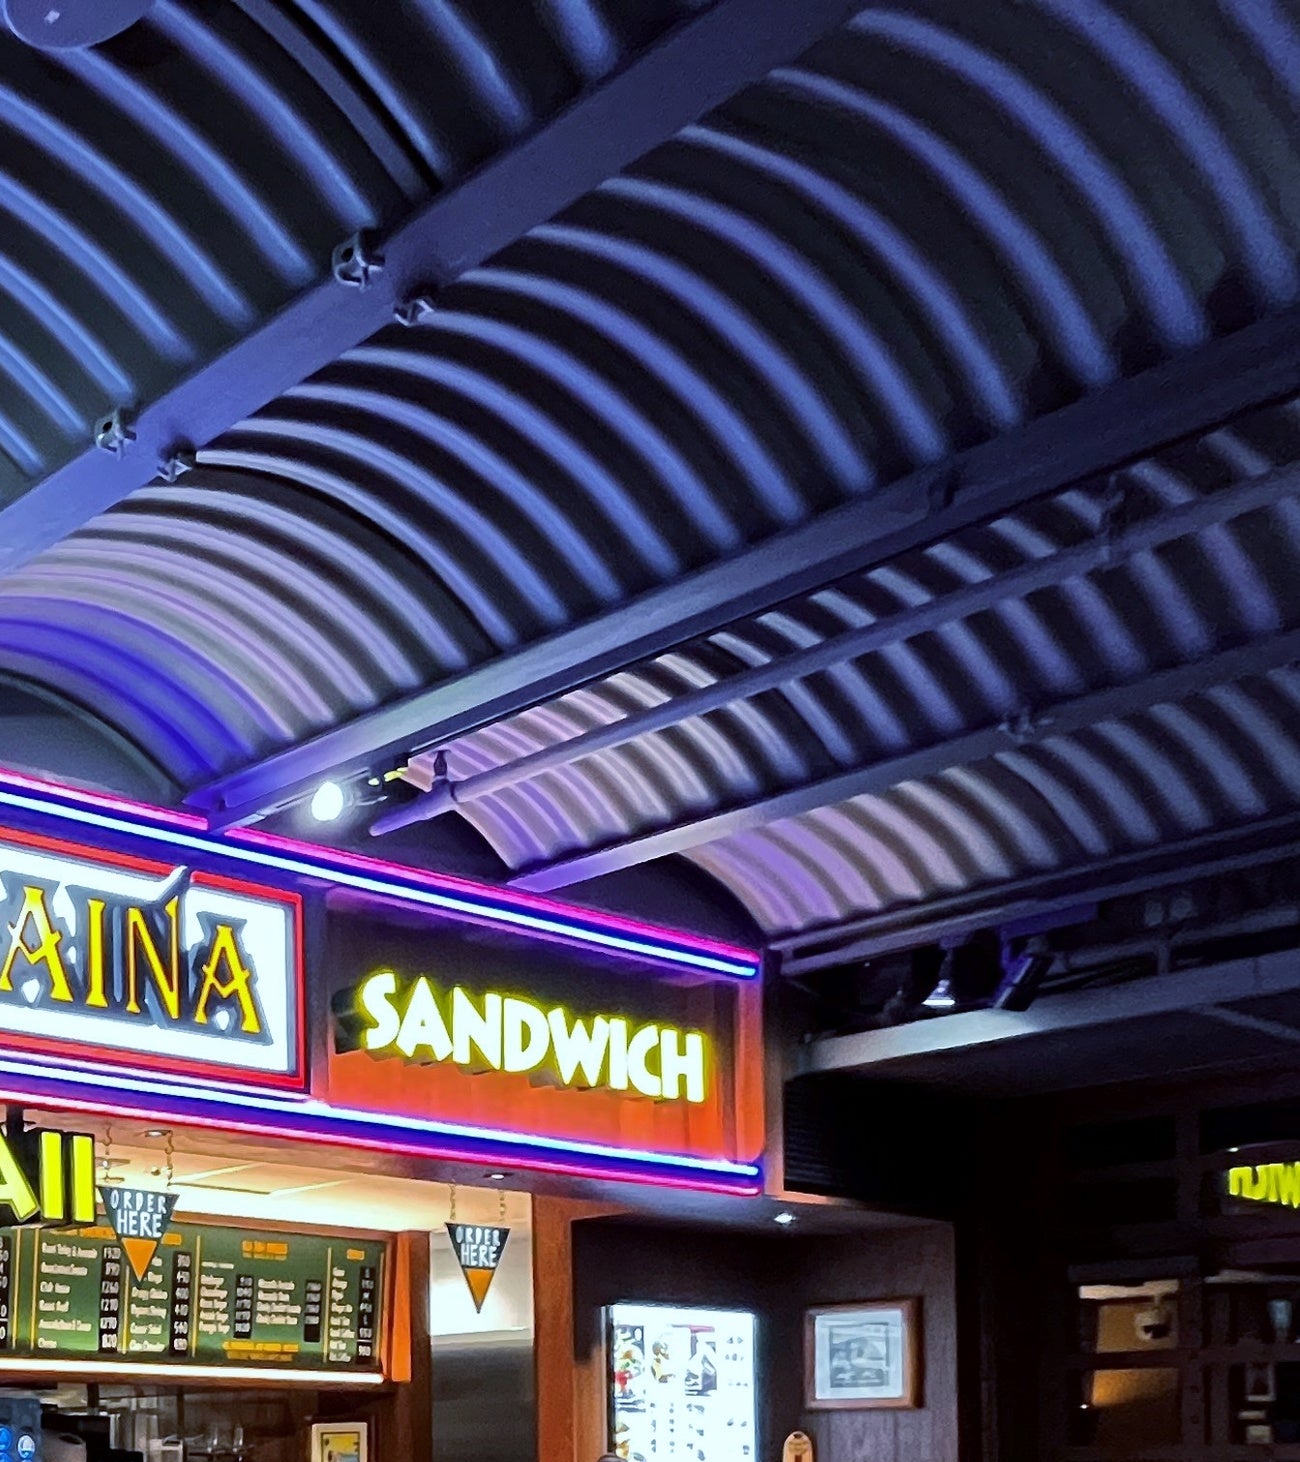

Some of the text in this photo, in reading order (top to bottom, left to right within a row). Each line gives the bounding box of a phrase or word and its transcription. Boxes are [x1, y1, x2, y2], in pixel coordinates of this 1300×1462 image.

[361, 971, 704, 1103] SANDWICH
[110, 1189, 167, 1214] ORDER
[116, 1208, 163, 1238] HERE
[455, 1225, 500, 1246] ORDER
[460, 1243, 497, 1267] HERE
